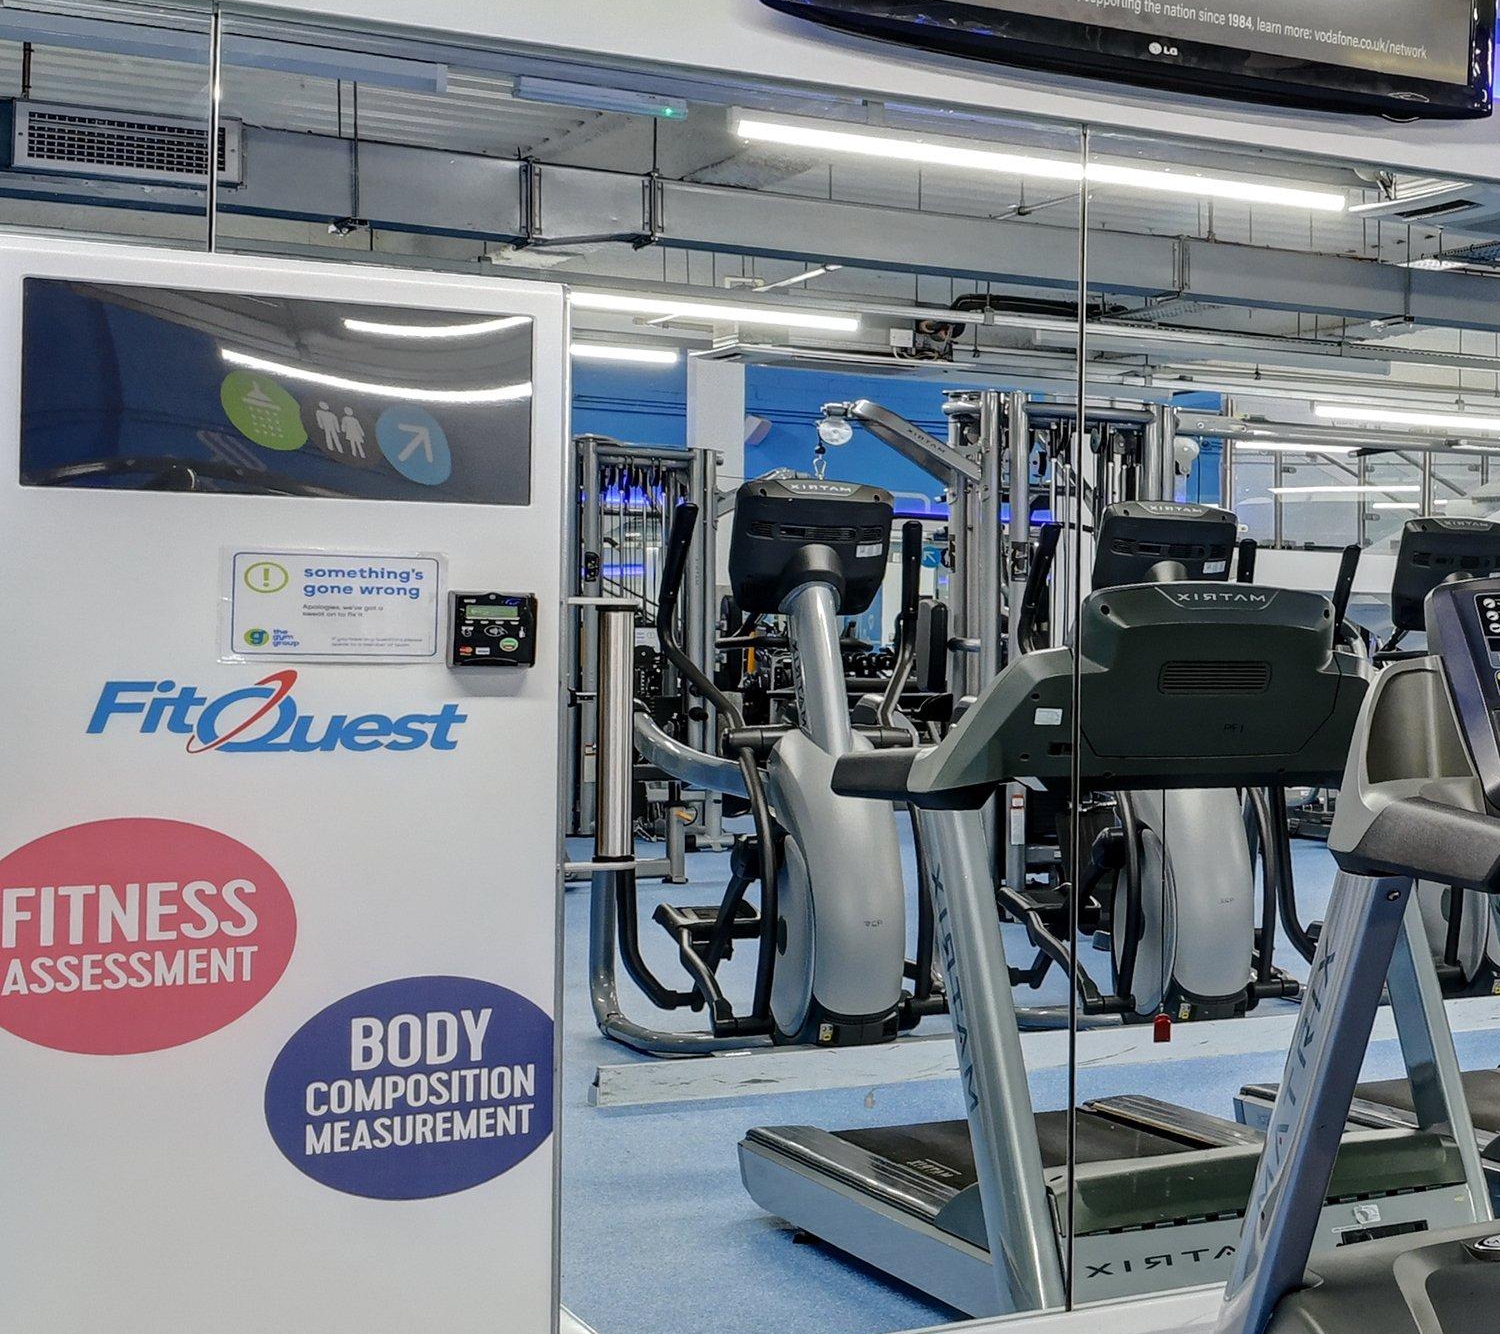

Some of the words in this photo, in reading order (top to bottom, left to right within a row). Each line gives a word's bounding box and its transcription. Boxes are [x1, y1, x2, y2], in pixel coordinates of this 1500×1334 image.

[1163, 45, 1178, 56] LG
[1164, 3, 1196, 20] nation
[1199, 9, 1225, 25] since
[1228, 12, 1255, 32] 1984,
[1257, 17, 1282, 35] learn
[1284, 24, 1312, 40] more:
[1314, 29, 1428, 59] vodafone.co.uk/network
[303, 584, 354, 598] gone
[360, 584, 421, 600] wrong
[304, 566, 424, 582] something's
[272, 634, 294, 643] gym
[272, 640, 300, 649] group
[86, 669, 467, 754] FitQuest
[1, 879, 259, 949] FITNESS
[0, 944, 259, 998] ASSESSMENT
[350, 1008, 494, 1071] BODY
[305, 1063, 536, 1117] COMPOSITION
[305, 1103, 536, 1156] MEASUREMENT
